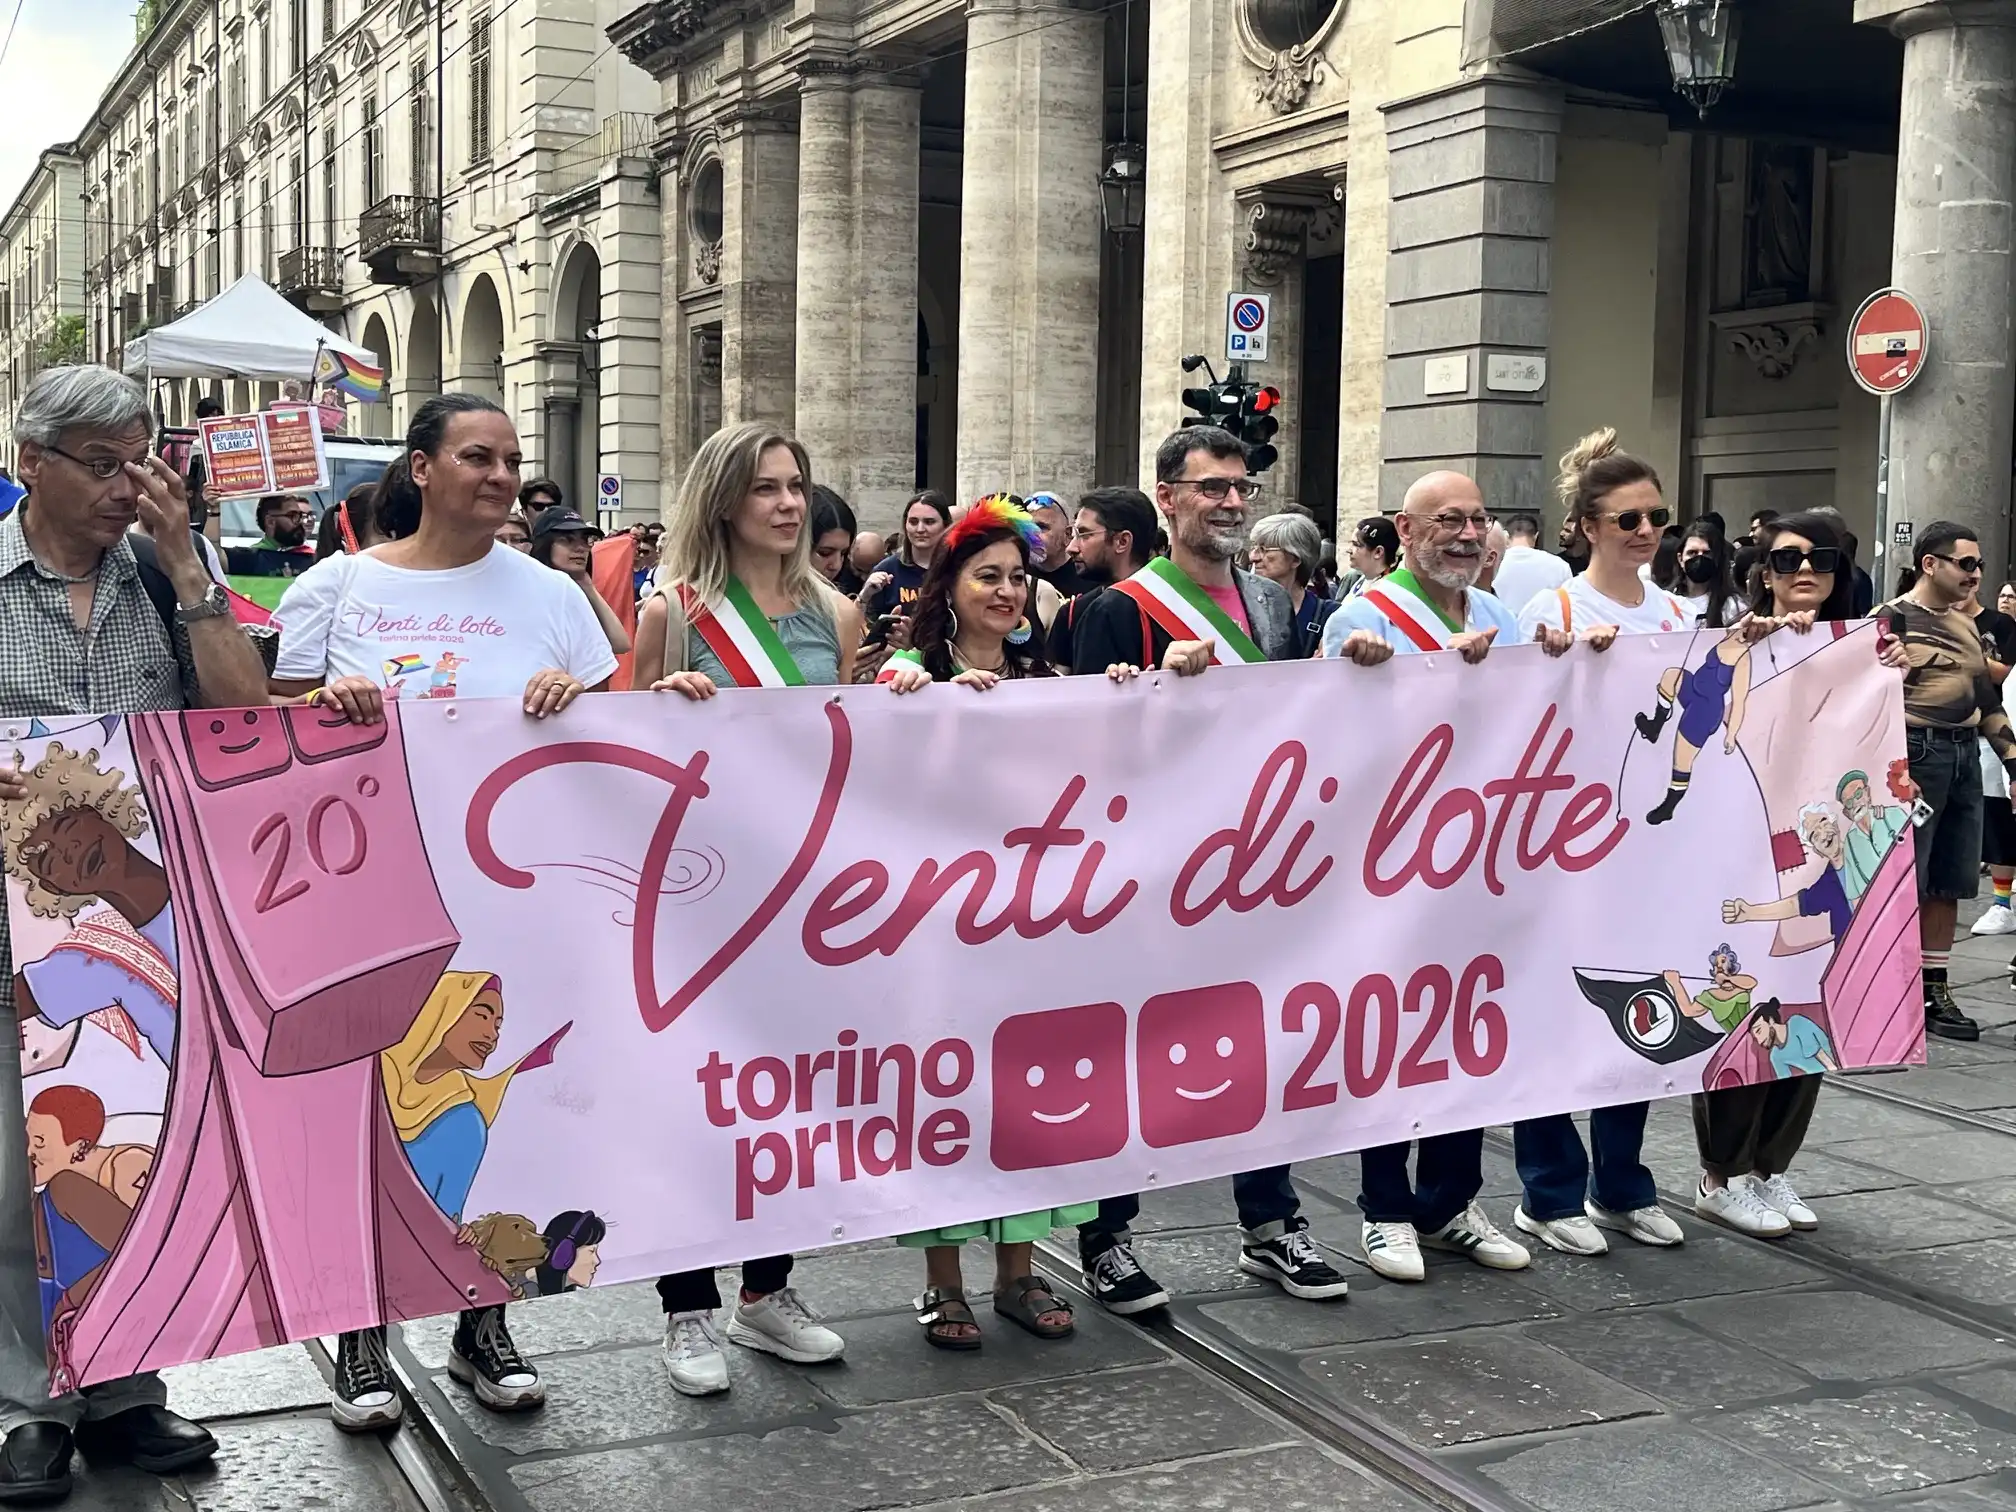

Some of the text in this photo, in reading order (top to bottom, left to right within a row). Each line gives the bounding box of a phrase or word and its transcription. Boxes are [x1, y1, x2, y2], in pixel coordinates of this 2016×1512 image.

[212, 430, 254, 443] REPUBBLICA
[217, 439, 253, 452] ISLAMICA
[340, 606, 507, 637] Venti di lotte
[379, 634, 465, 644] torino pride 2026
[465, 699, 1630, 1034] Venti di lotte
[1282, 953, 1508, 1113] 2026
[697, 1028, 974, 1128] torino
[734, 1108, 971, 1221] pride
